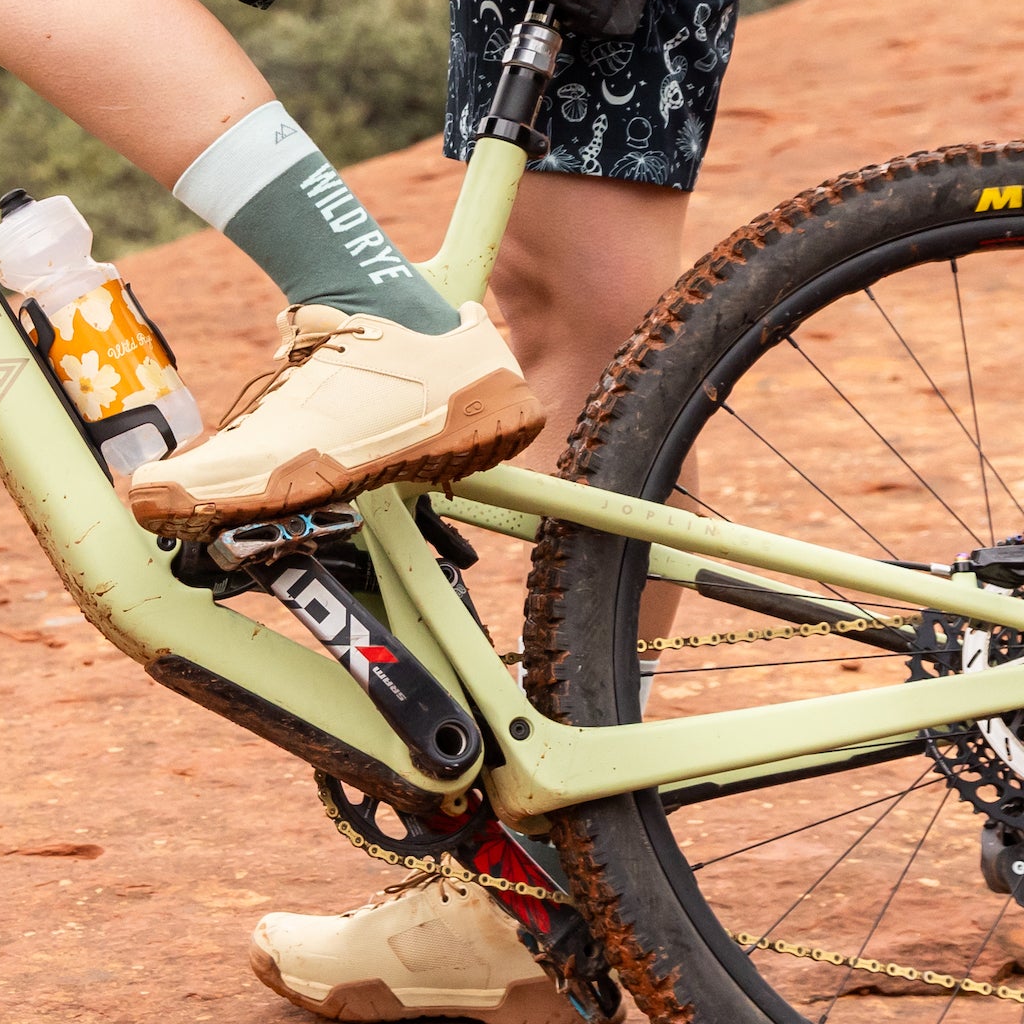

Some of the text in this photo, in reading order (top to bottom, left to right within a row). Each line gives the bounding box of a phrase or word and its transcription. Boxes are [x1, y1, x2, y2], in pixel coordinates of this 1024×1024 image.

[300, 163, 413, 285] WILD RYE
[107, 337, 138, 359] Wild
[601, 499, 716, 536] JOPLIN
[372, 666, 406, 701] SRAM
